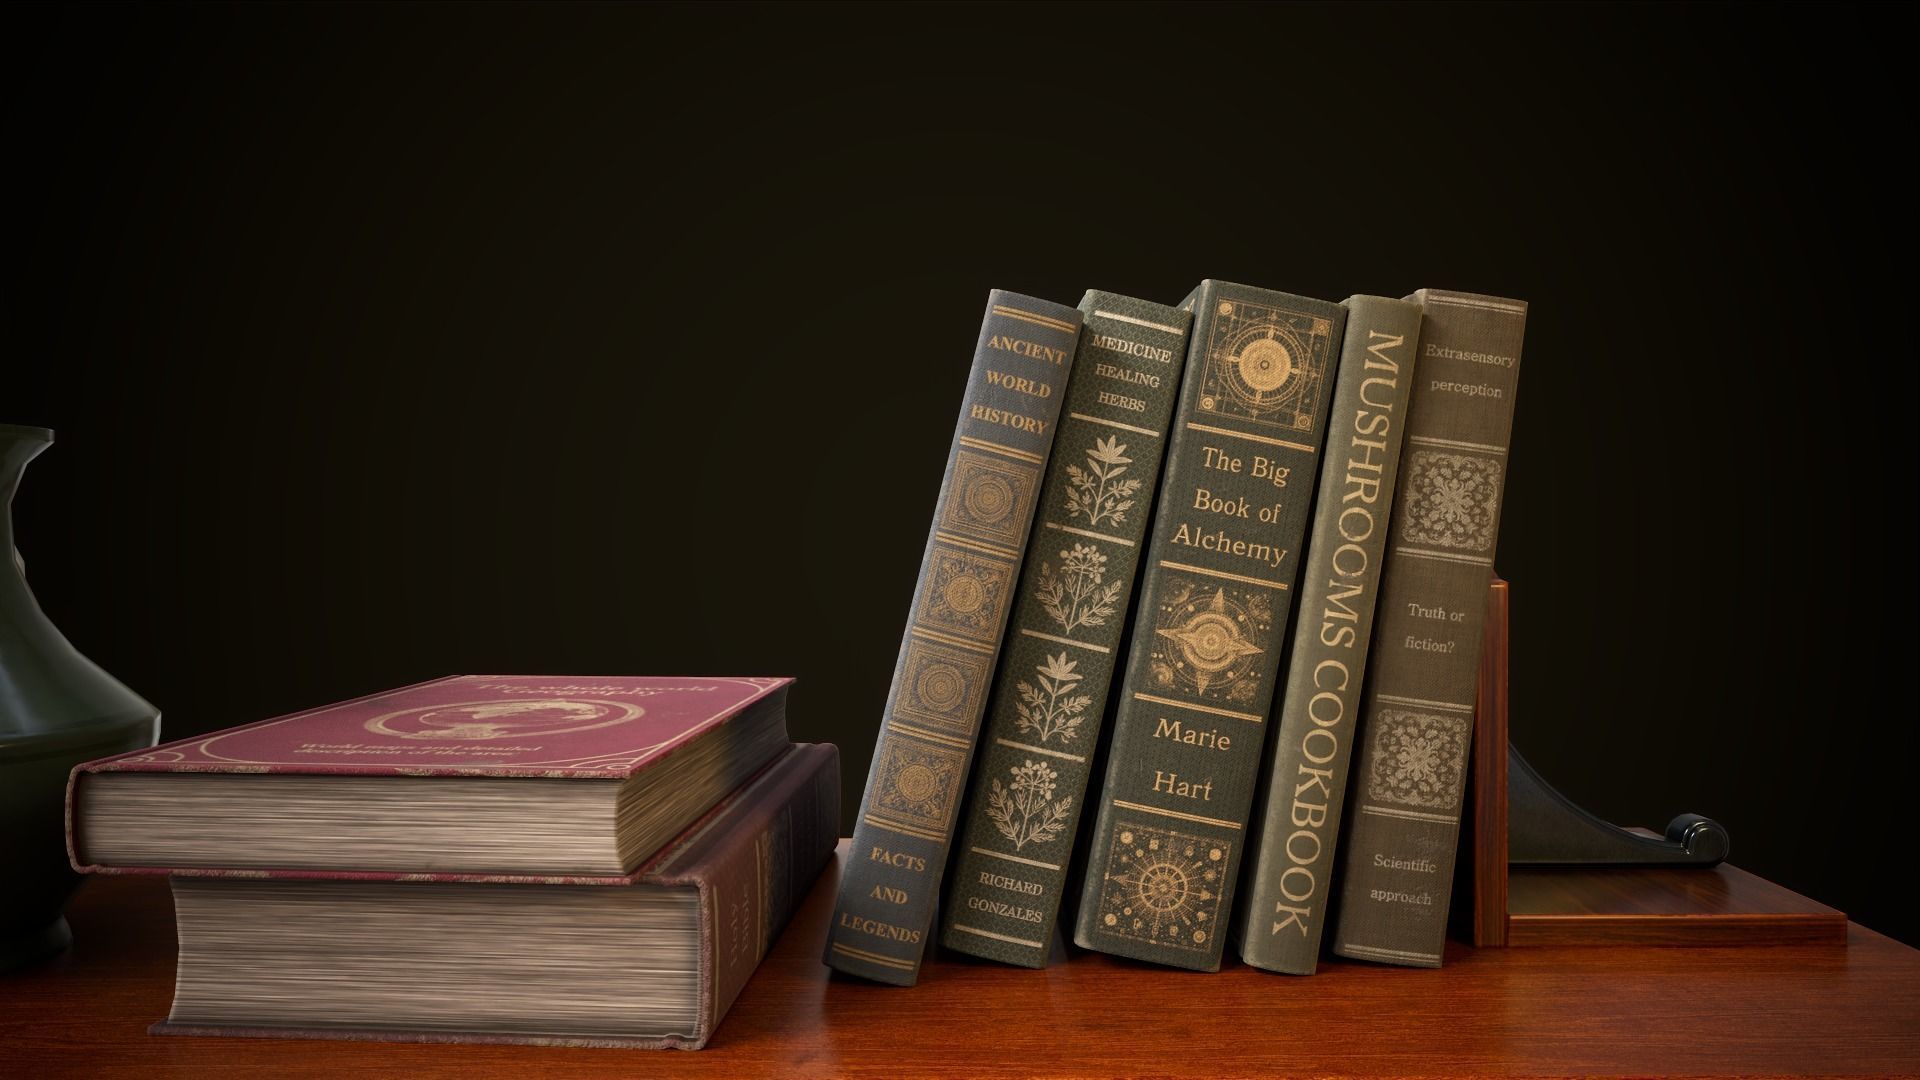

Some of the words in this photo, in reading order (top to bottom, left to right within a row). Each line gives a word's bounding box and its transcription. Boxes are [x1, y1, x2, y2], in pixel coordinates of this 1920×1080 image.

[988, 334, 1067, 366] ANCIENT
[1092, 334, 1172, 363] MEDICINE
[1426, 343, 1516, 369] Extrasensory
[986, 370, 1052, 398] WORLD
[1095, 363, 1160, 389] HEALING
[1431, 379, 1502, 399] perception
[1098, 391, 1146, 413] HERBS
[971, 405, 1048, 435] HISTORY
[1202, 447, 1244, 473] The
[1250, 455, 1290, 487] Big
[1319, 330, 1404, 649] MUSHROOMS
[1194, 490, 1250, 518] Book
[1258, 503, 1282, 524] of
[1171, 525, 1288, 567] Alchemy
[1408, 603, 1445, 622] Truth
[1449, 609, 1465, 623] or
[1405, 636, 1455, 655] fiction?
[477, 683, 530, 691] The
[1154, 717, 1231, 752] Marie
[1154, 771, 1212, 802] Hart
[1272, 658, 1350, 938] COOKBOOK
[870, 847, 926, 873] FACTS
[1374, 854, 1437, 873] Scientific
[870, 885, 908, 906] AND
[979, 872, 1043, 897] RICHARD
[1370, 889, 1432, 905] approach
[968, 895, 1043, 924] GONZALES
[840, 913, 921, 945] LEGENDS
